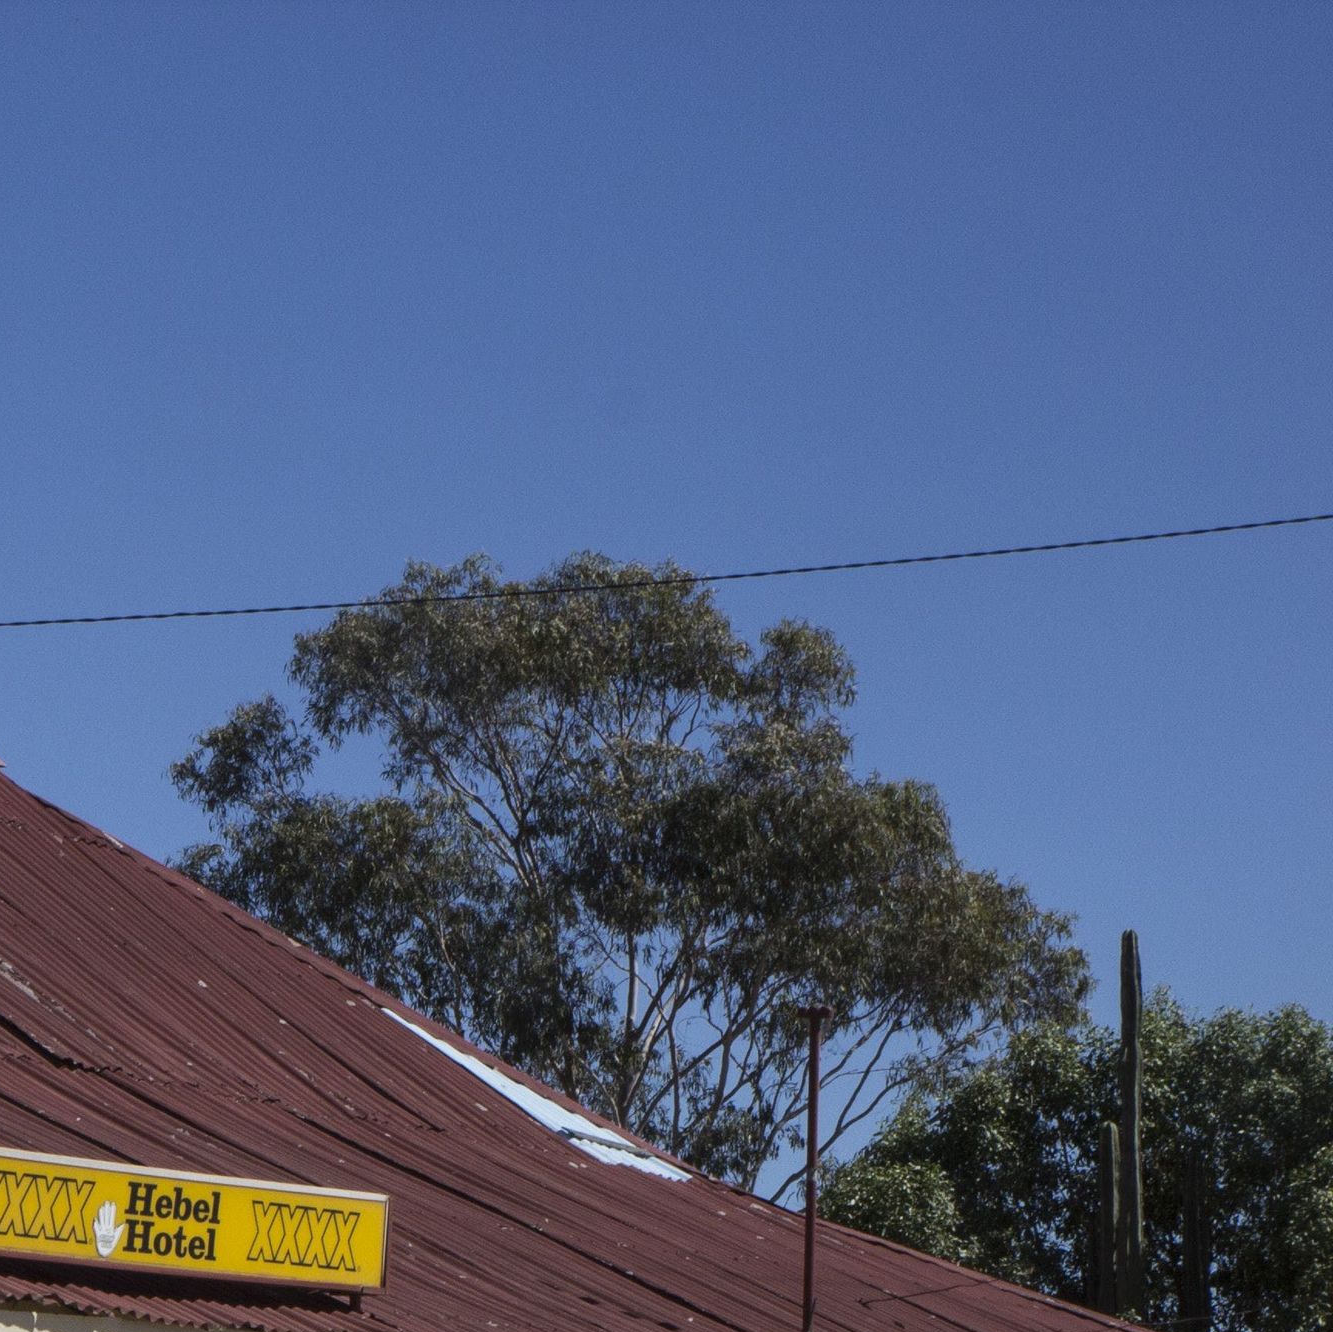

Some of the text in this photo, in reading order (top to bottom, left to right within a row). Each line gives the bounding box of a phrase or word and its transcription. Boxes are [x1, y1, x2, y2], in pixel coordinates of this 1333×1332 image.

[124, 1181, 221, 1225] Hebel
[122, 1219, 217, 1261] Hotel
[247, 1200, 361, 1272] XXXX
